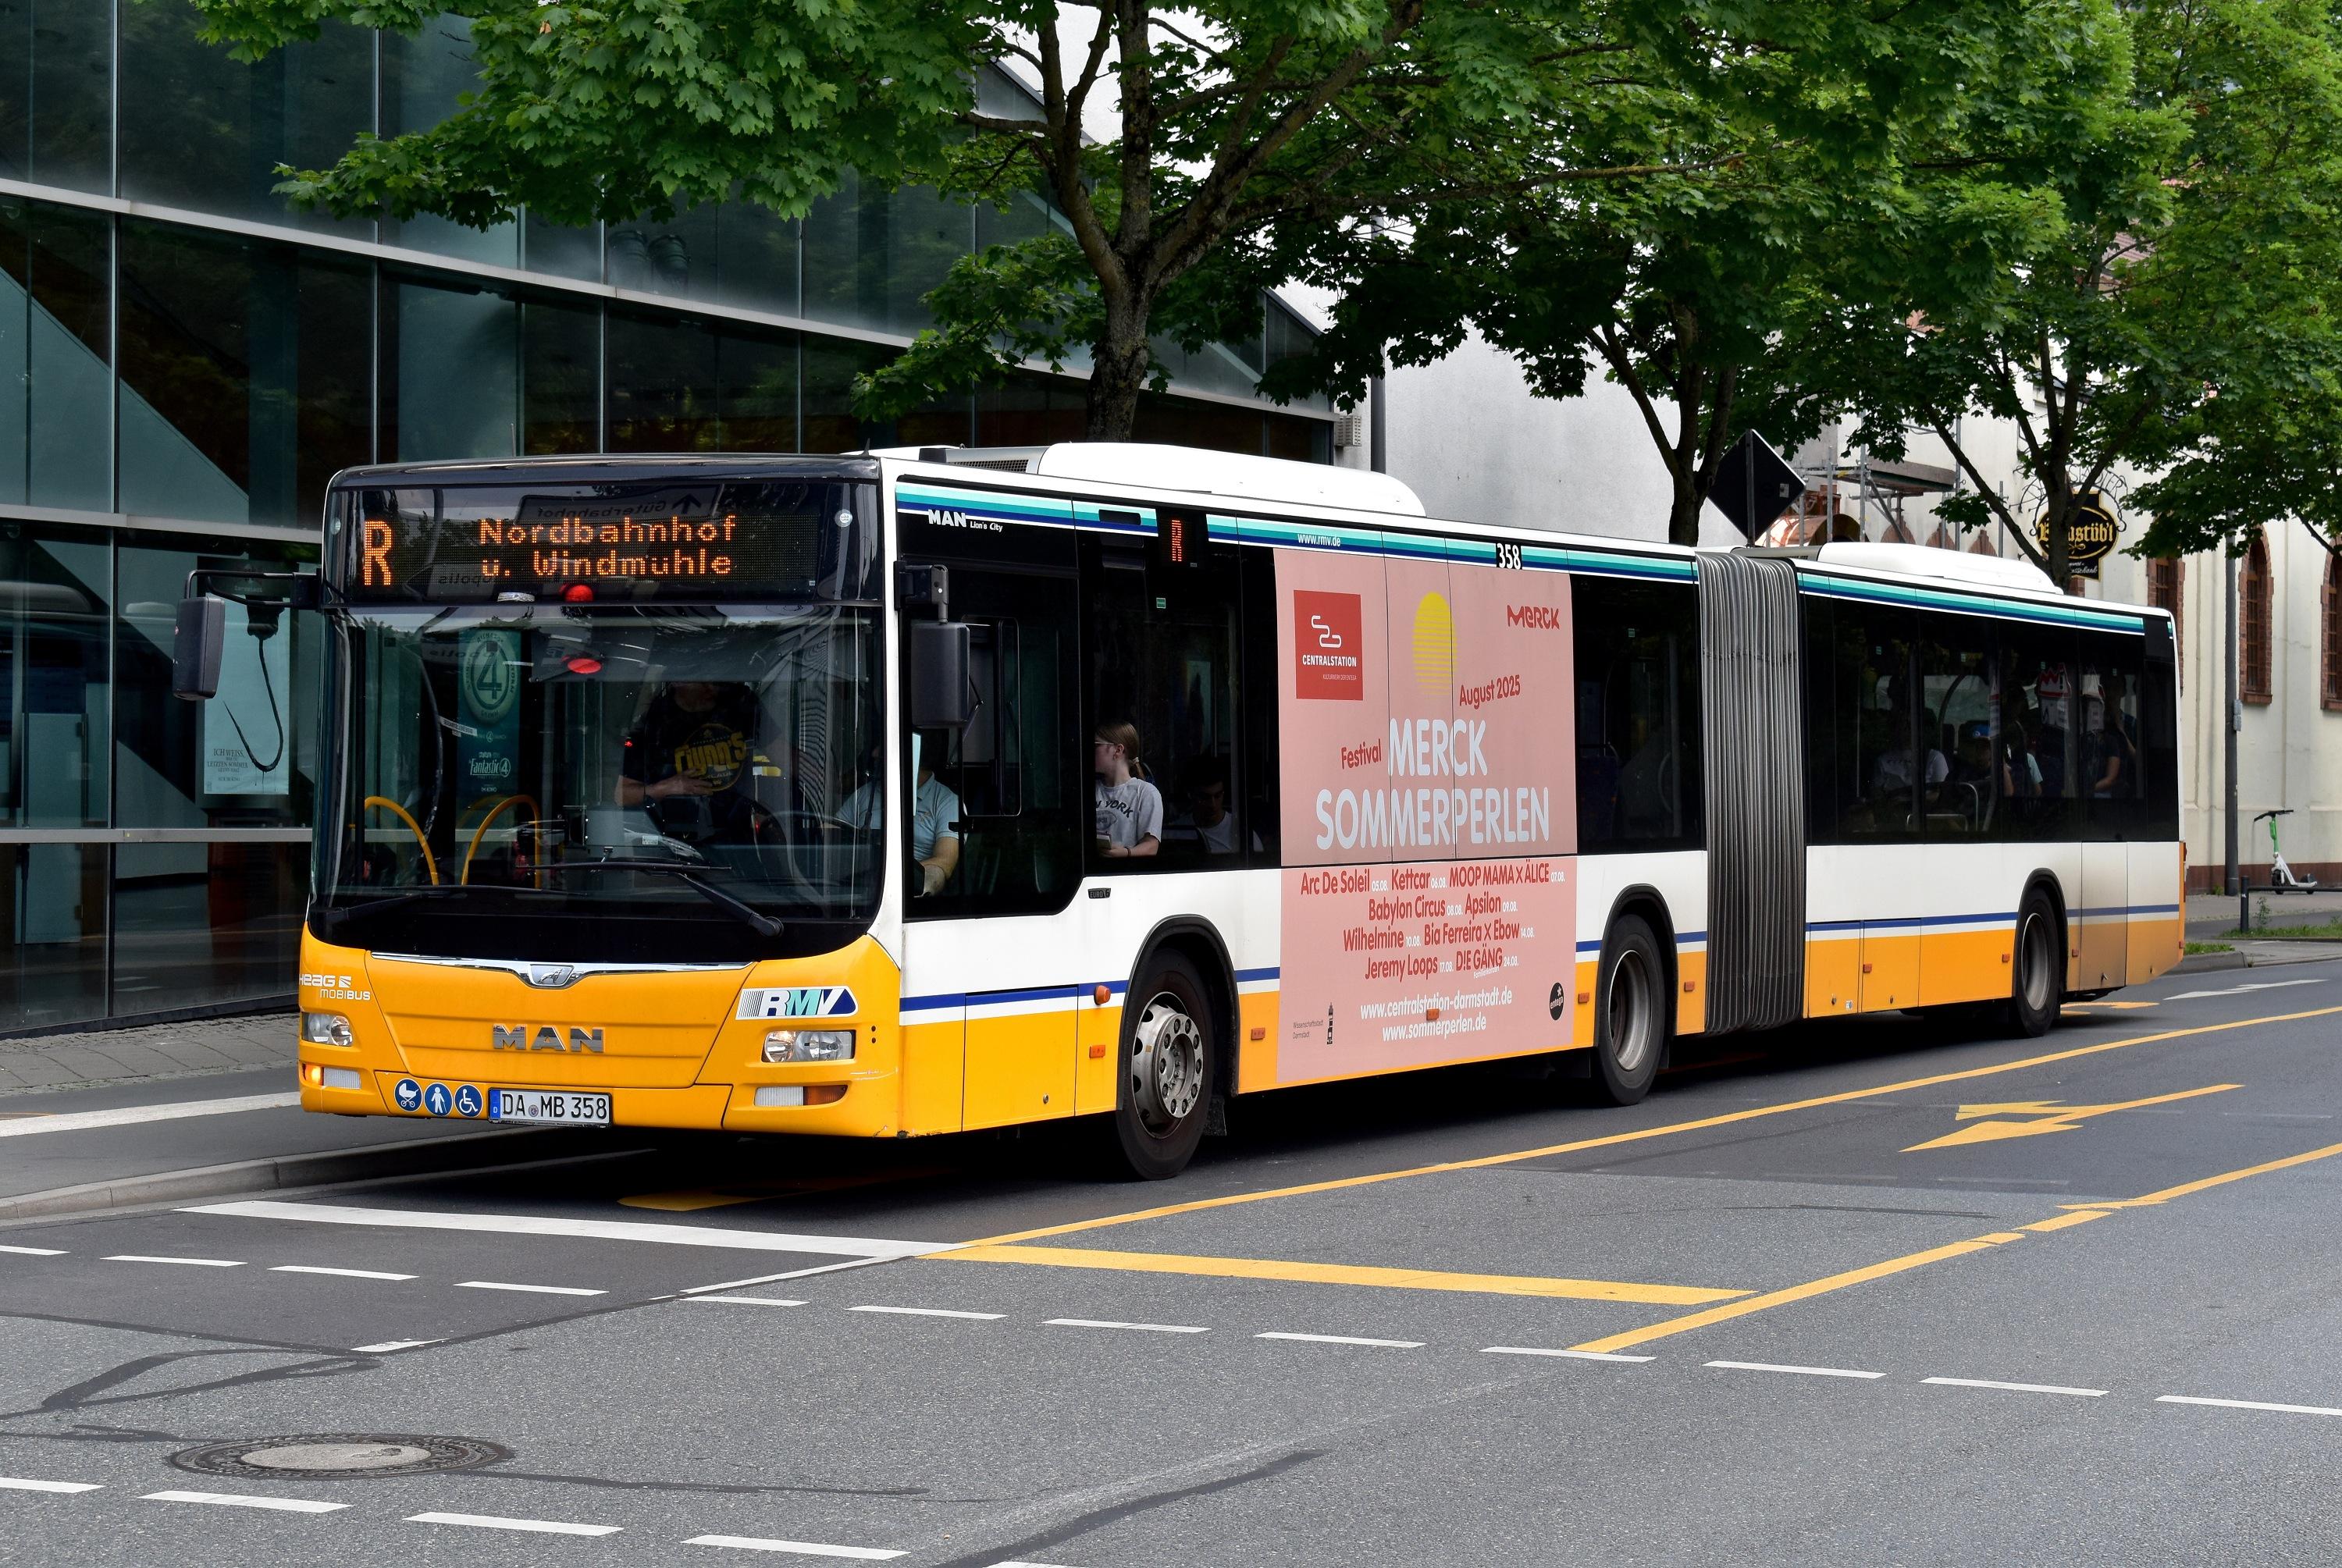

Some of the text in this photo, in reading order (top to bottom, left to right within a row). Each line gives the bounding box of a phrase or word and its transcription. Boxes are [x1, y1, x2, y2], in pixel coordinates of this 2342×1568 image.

[479, 514, 737, 545] Nordbahnhof
[927, 509, 1003, 532] MAN Lion's City
[363, 519, 392, 586] R
[1171, 519, 1182, 561] R
[1297, 533, 1341, 548] www.rmv.de
[533, 548, 733, 576] Windmühle
[1497, 542, 1522, 571] 358
[1506, 605, 1561, 630] MERCK
[1302, 654, 1357, 667] CENTRALSTATION
[1459, 674, 1521, 710] August 2025
[1340, 738, 1382, 770] Festival
[1389, 718, 1488, 777] MERCK
[470, 758, 500, 776] Fantastic
[1105, 799, 1134, 819] YORK
[1316, 787, 1550, 851] SOMMERPERLEN
[1301, 872, 1320, 895] Arc
[1322, 871, 1338, 894] De
[1340, 868, 1370, 894] Soleil
[1372, 880, 1389, 892] 05.08.
[1391, 868, 1431, 891] Kettcar
[1430, 877, 1447, 889] 06.08.
[1449, 866, 1482, 888] MOOP
[1482, 864, 1514, 886] MAMA
[1524, 859, 1550, 884] ÄLICE
[1369, 896, 1412, 926] Babylon
[1415, 894, 1446, 919] Circus
[1465, 891, 1501, 920] Apsilon
[1343, 925, 1404, 952] Wilhelmine
[1405, 935, 1422, 948] 10.08.
[1424, 923, 1440, 946] Bia
[1443, 920, 1482, 944] Ferreira
[1493, 918, 1520, 941] Ebow
[1365, 957, 1405, 983] Jeremy
[1407, 954, 1438, 980] Loops
[1456, 950, 1472, 972] D!E
[1473, 944, 1503, 970] GÄNG
[758, 987, 845, 1017] RMV
[1360, 985, 1513, 1020] www.centralstation-darmstadt.de
[1549, 995, 1564, 1009] entega
[493, 1023, 605, 1054] MAN
[1292, 1031, 1310, 1040] Darmstadt
[1383, 1012, 1486, 1042] www.sommerperlen.de
[502, 1093, 607, 1120] DA MB 358
